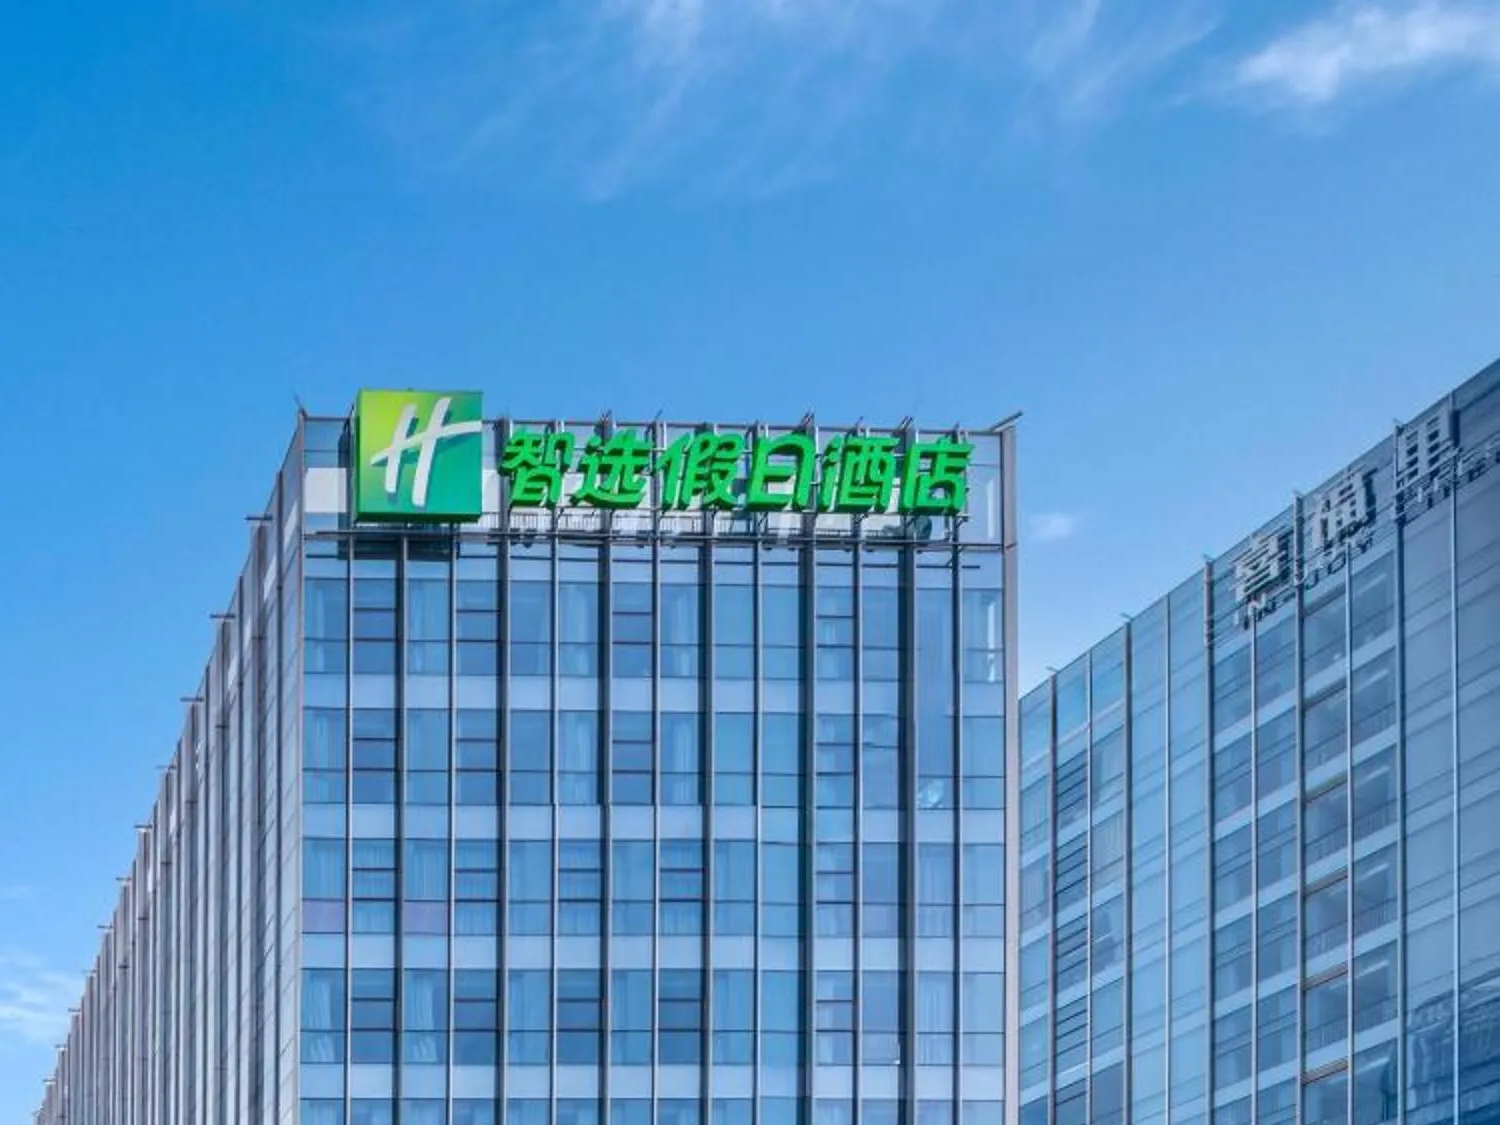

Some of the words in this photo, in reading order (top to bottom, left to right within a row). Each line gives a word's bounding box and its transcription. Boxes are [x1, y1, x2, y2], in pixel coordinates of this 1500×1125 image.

[498, 426, 972, 515] 智选假日酒店
